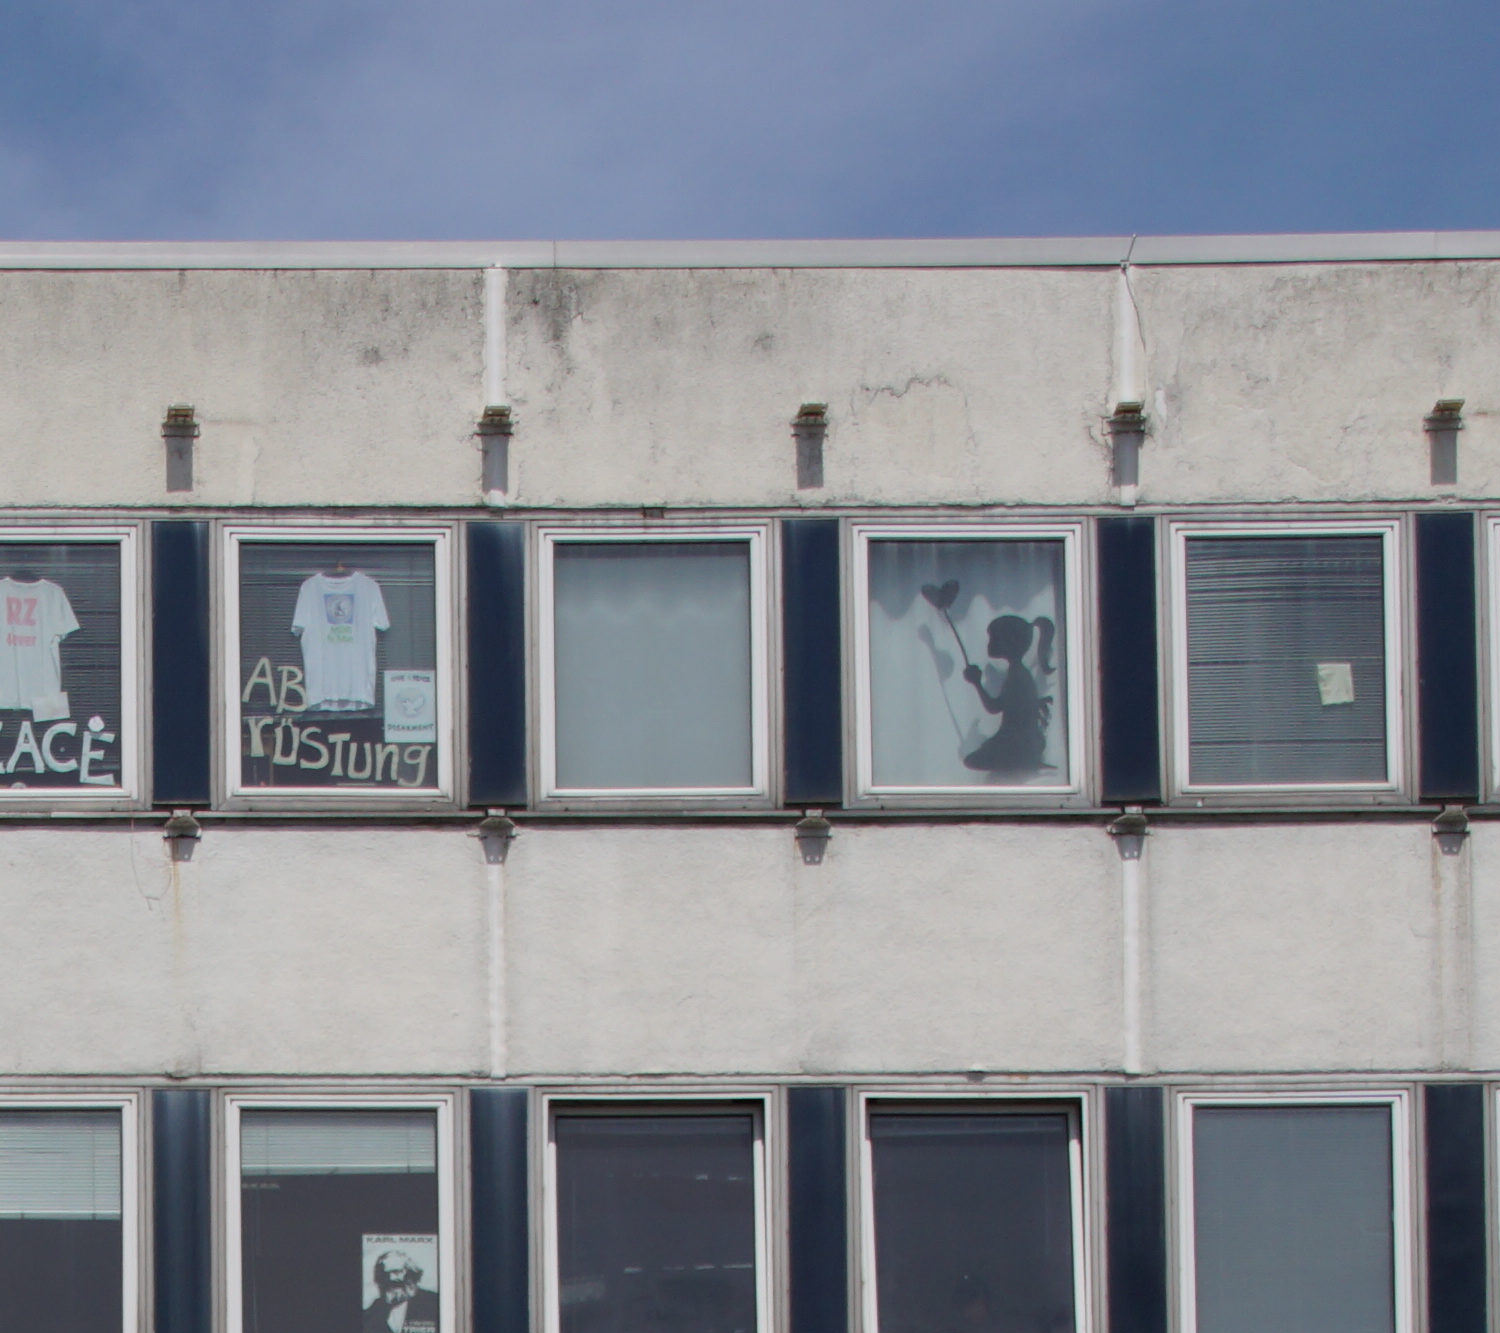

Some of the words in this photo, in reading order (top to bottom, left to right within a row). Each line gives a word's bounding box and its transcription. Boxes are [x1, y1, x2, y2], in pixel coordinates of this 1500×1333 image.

[6, 597, 38, 626] RZ
[243, 656, 306, 714] AB
[399, 1236, 434, 1244] MARX
